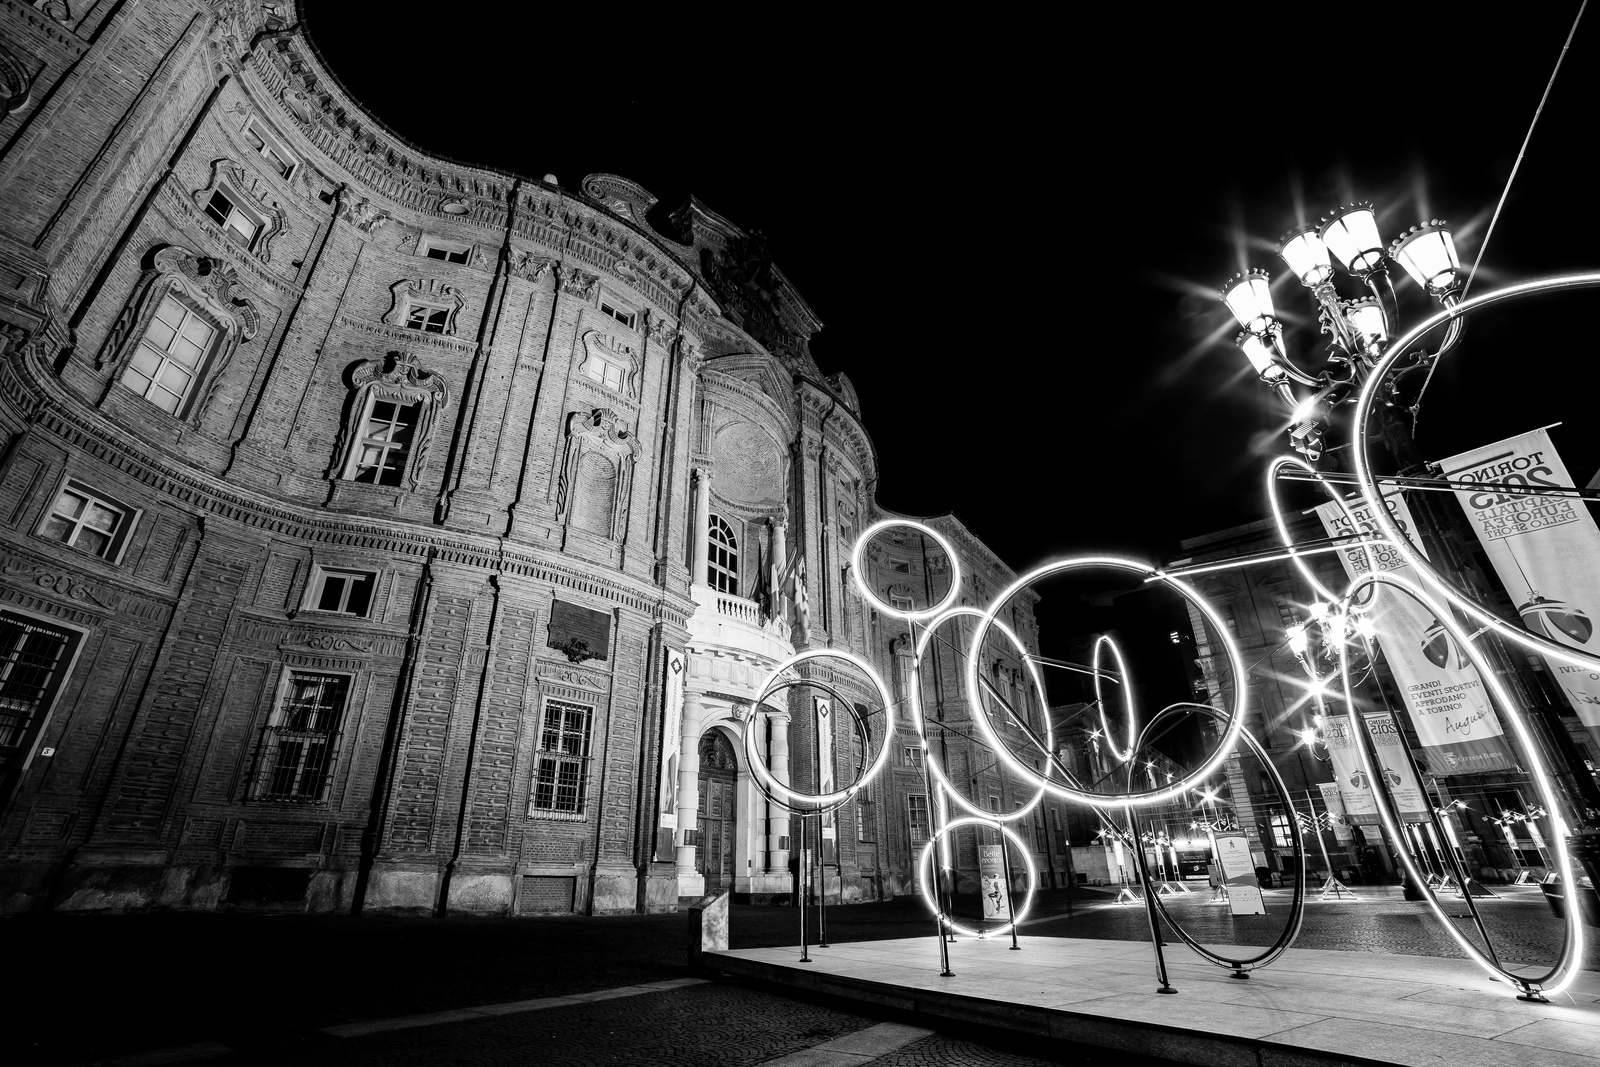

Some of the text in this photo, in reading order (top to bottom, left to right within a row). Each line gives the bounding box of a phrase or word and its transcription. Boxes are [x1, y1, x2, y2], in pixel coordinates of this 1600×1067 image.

[1408, 680, 1441, 692] GRANDI
[1411, 680, 1479, 700] EVENTI SPORTIVI
[1415, 693, 1466, 708] APPRODANO
[1426, 703, 1463, 714] TORINO!
[983, 850, 1000, 858] Belle
